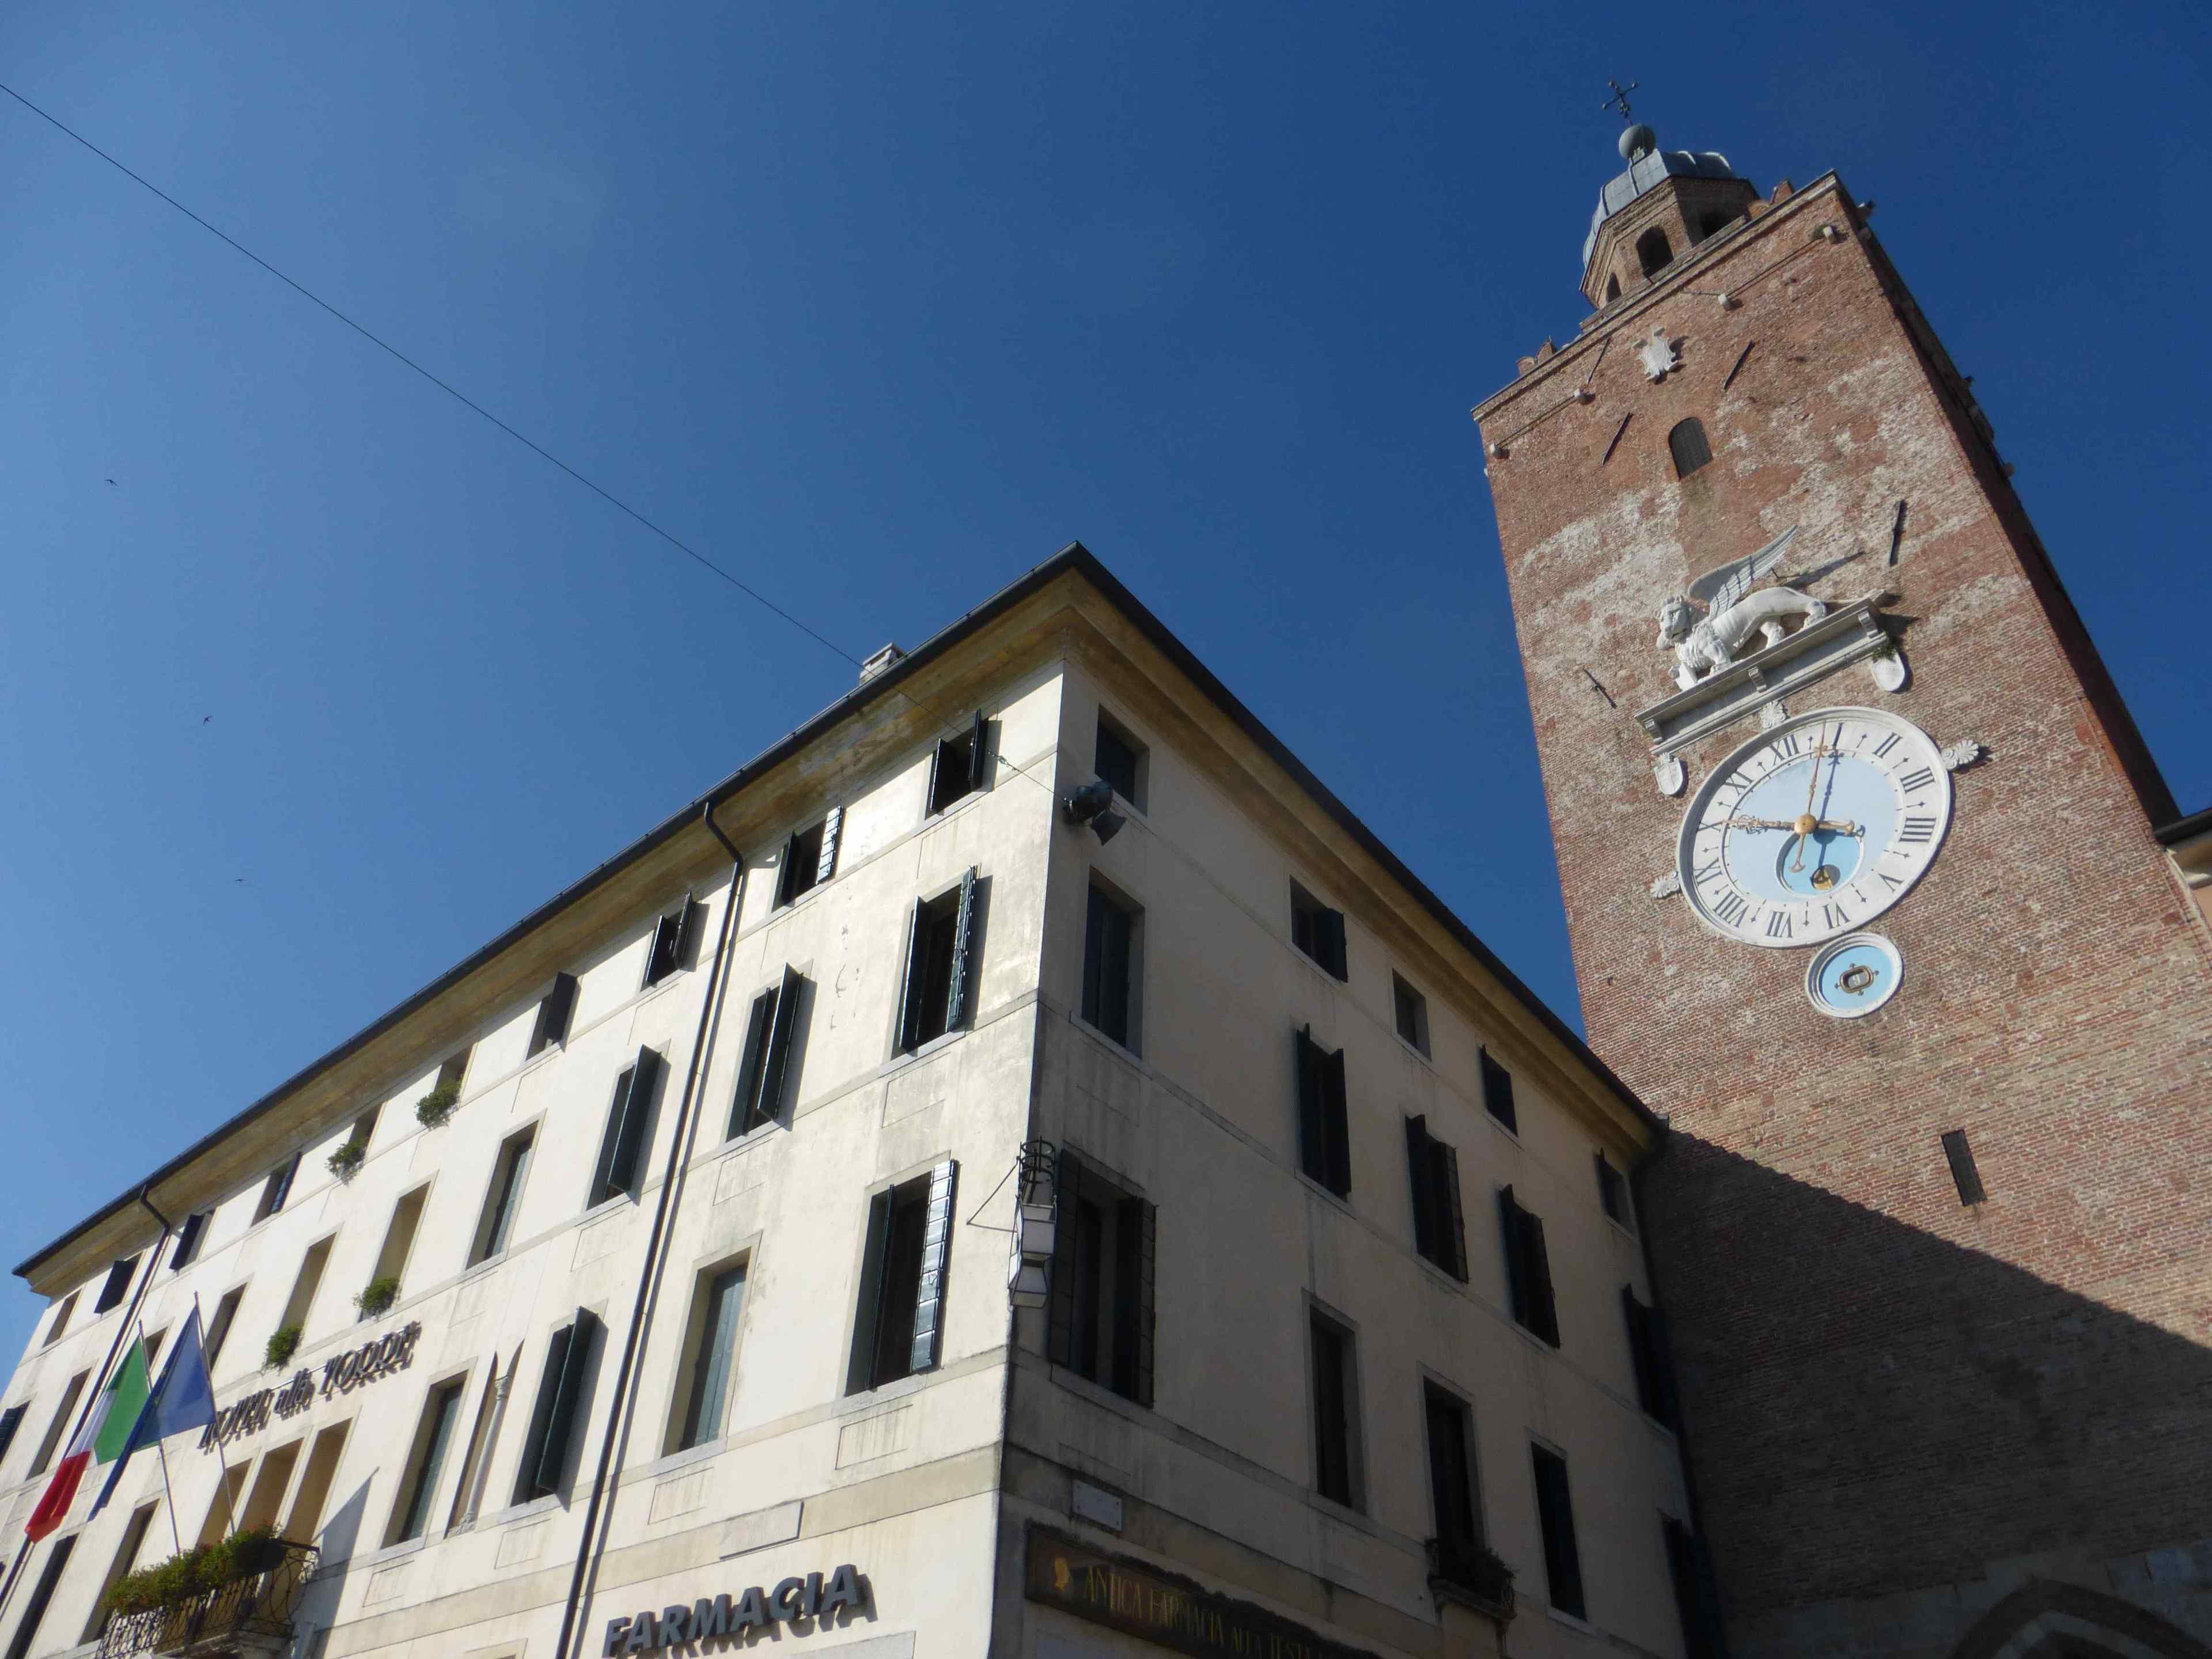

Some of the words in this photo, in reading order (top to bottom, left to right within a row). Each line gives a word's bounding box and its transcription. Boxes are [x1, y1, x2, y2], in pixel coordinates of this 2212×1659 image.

[1768, 734, 1800, 766] XII
[1872, 732, 1903, 759] II
[1723, 770, 1755, 796] XI
[1899, 766, 1936, 794] III
[1898, 816, 1937, 843] IIII
[1694, 857, 1724, 886] IX
[1878, 873, 1904, 893] V
[1713, 889, 1750, 929] VIII
[1822, 902, 1851, 930] VI
[1766, 911, 1793, 938] VII
[601, 1563, 862, 1659] FARMACIA
[1083, 1565, 1143, 1619] ANTICA
[1149, 1588, 1226, 1649] FARMACIA
